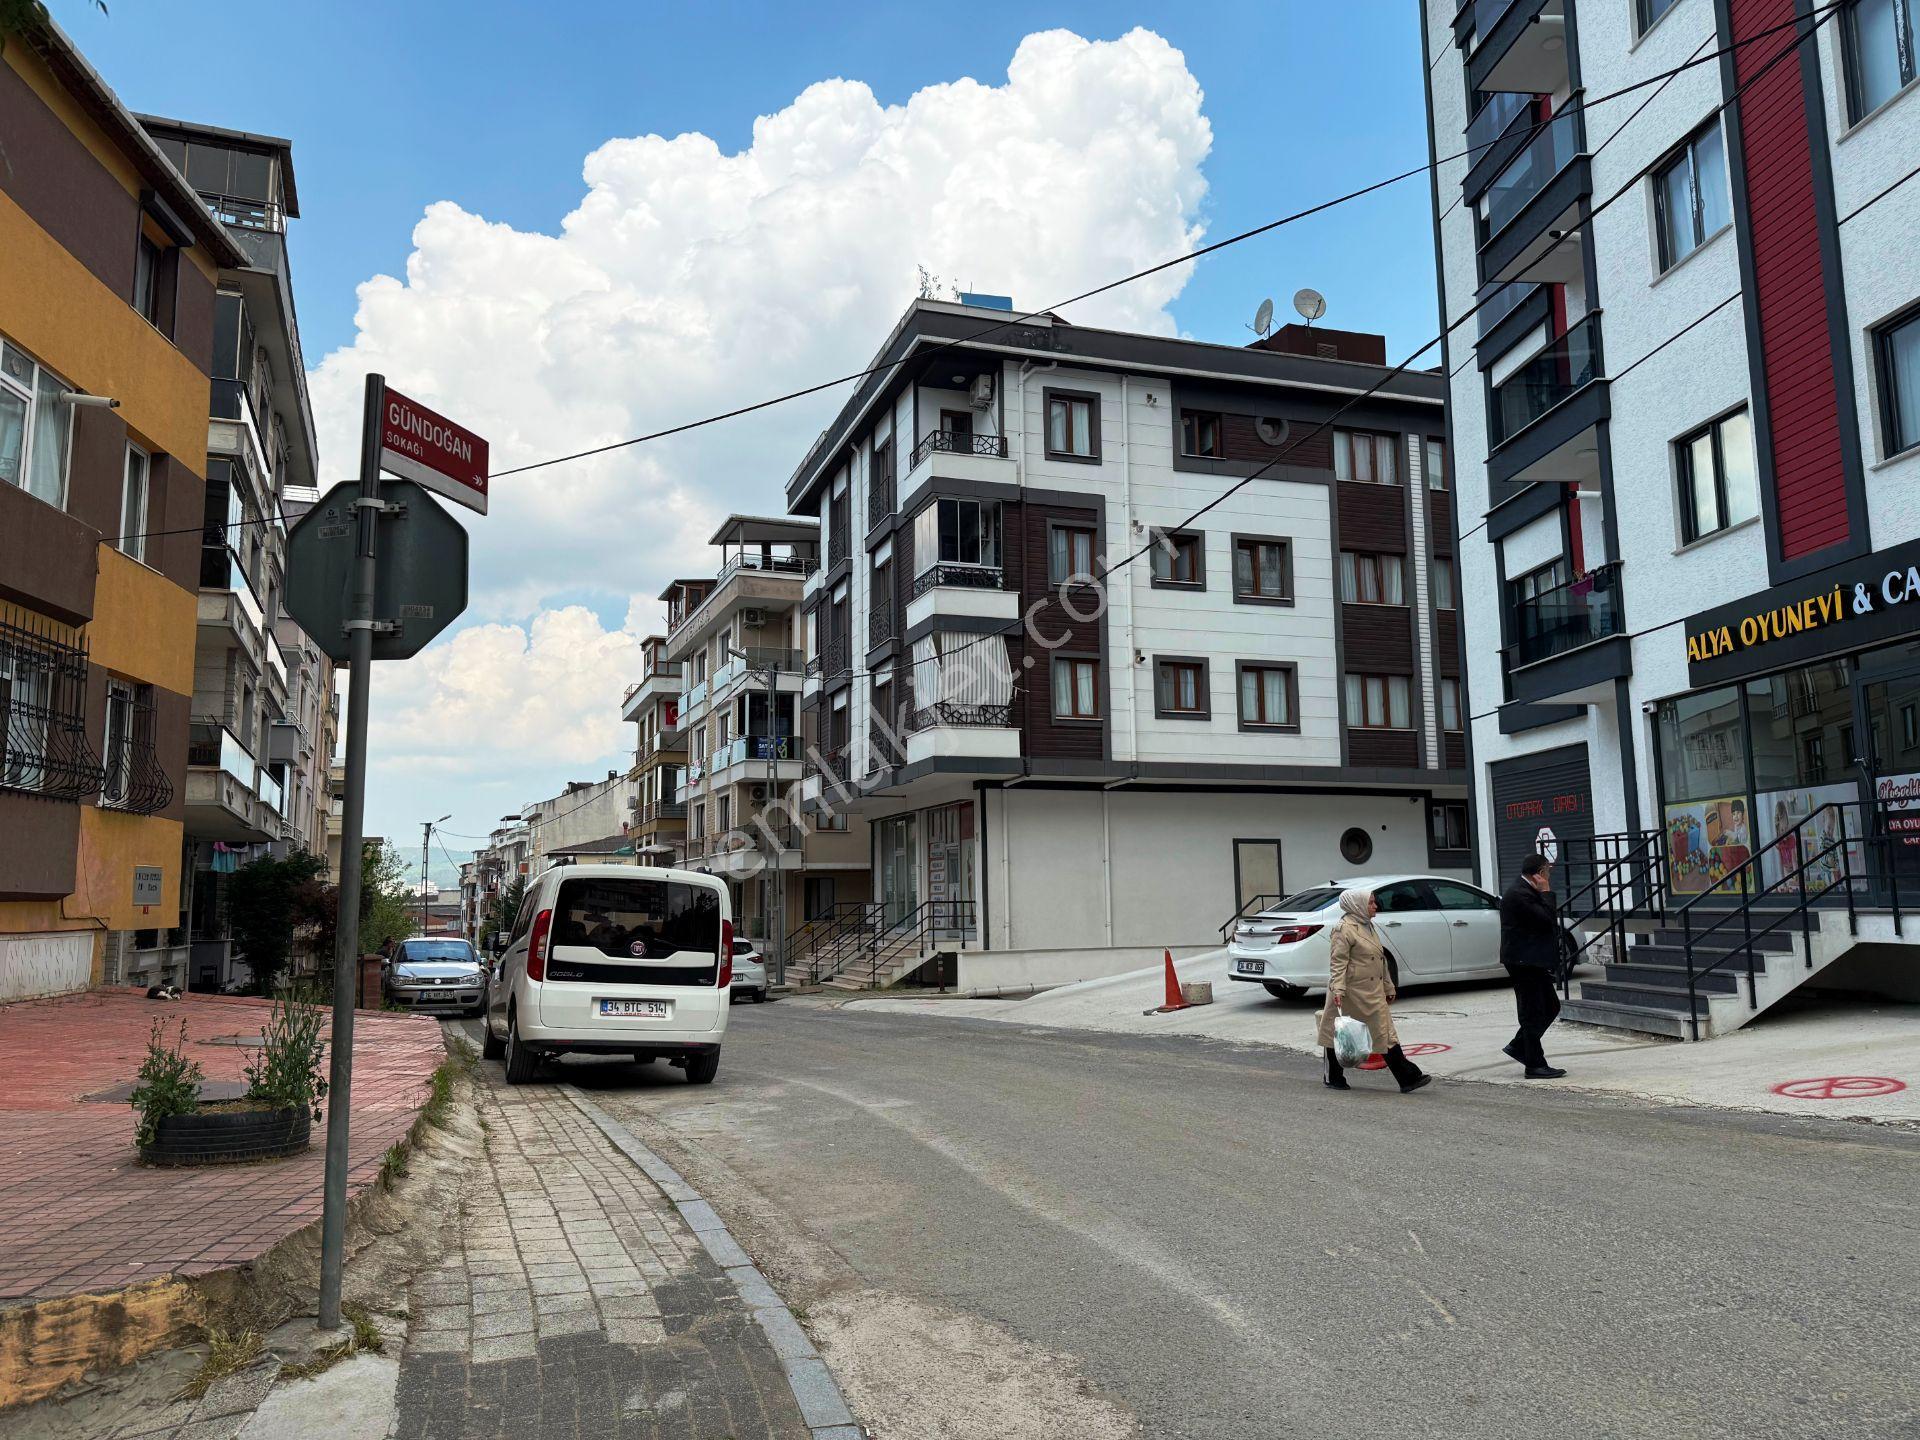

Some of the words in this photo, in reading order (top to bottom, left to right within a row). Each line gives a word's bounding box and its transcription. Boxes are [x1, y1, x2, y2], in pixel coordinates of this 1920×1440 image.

[386, 431, 424, 457] SOKAĞI
[389, 403, 472, 463] GÜNDOĞAN
[1687, 625, 1734, 663] ALYA
[1740, 583, 1844, 646] OYUNEVİ
[1852, 582, 1874, 615] &
[1506, 800, 1544, 819] OTOPARK
[549, 970, 584, 978] DOBLO
[608, 1002, 619, 1012] 34
[624, 1002, 642, 1013] BTC
[648, 1003, 664, 1014] 514
